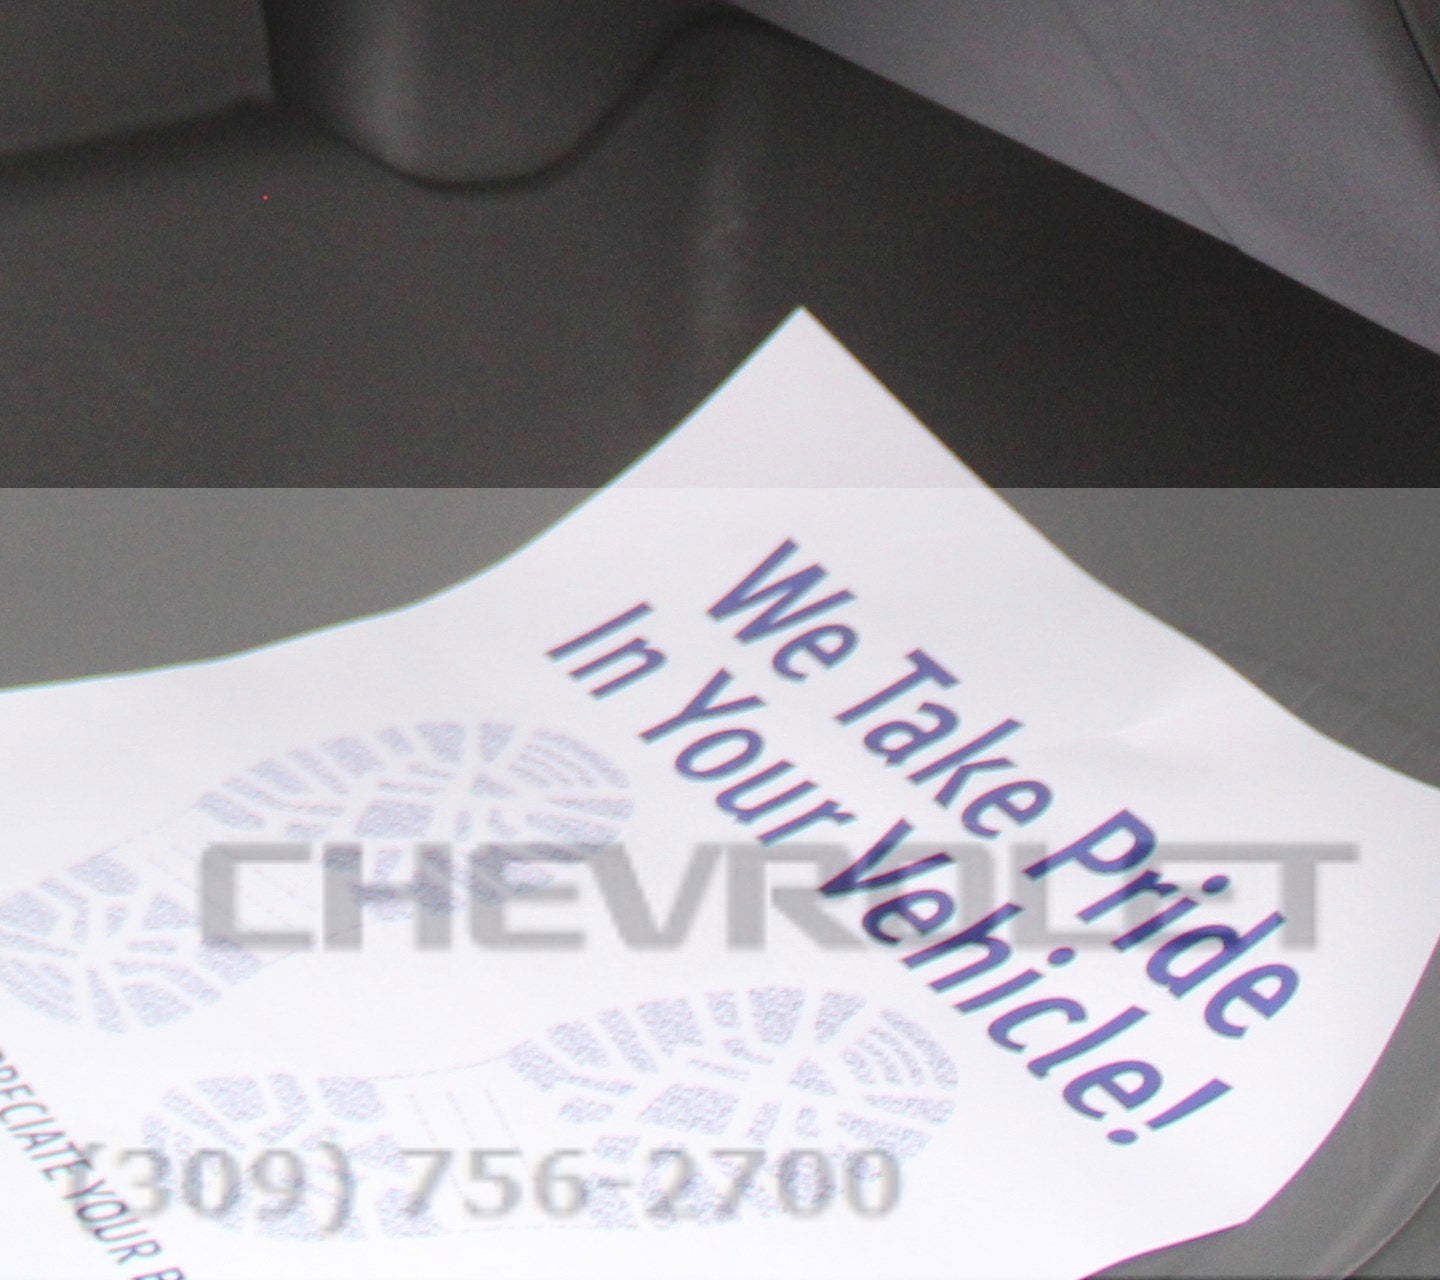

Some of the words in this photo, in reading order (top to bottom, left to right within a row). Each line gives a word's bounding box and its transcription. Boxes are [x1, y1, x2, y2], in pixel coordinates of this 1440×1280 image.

[545, 600, 670, 700] In
[638, 667, 858, 846] Your
[818, 817, 1234, 1146] Vehicle!
[705, 537, 861, 684] We
[833, 647, 1054, 840] Take
[1023, 807, 1302, 1040] Pride
[63, 1177, 163, 1266] YOUR
